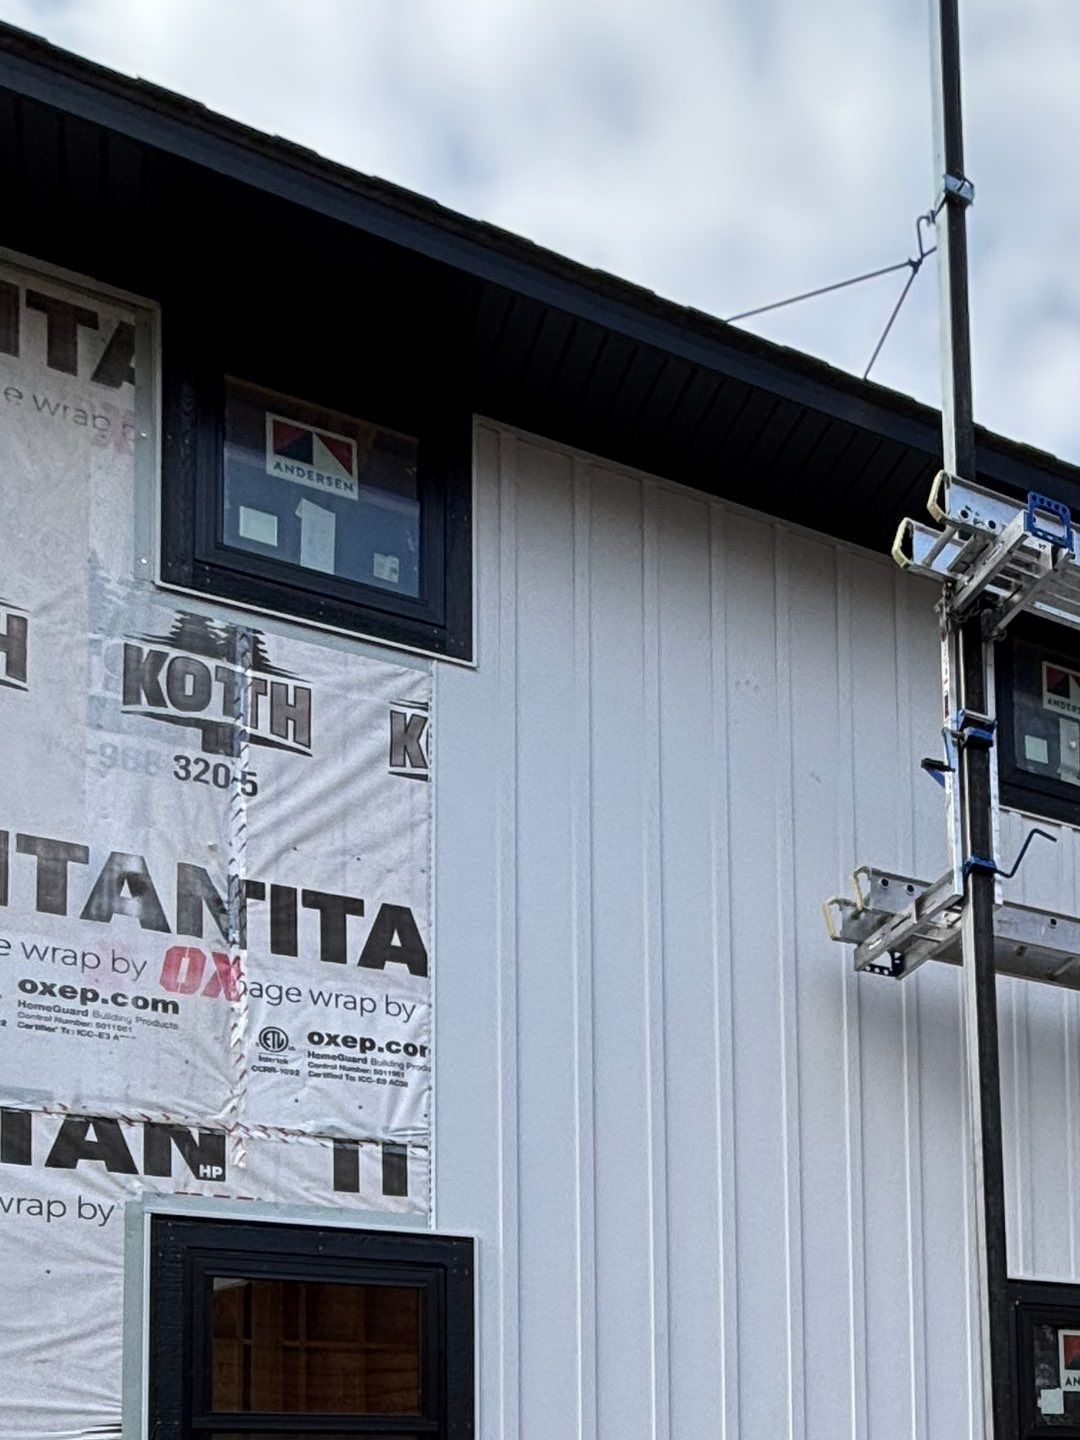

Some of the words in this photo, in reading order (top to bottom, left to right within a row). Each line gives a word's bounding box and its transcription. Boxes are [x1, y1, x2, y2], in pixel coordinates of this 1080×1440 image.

[32, 393, 111, 432] wrap
[273, 460, 354, 493] ANDERSEN
[122, 643, 312, 749] KOTH
[21, 938, 100, 973] wrap
[111, 946, 147, 982] by
[159, 945, 242, 1002] OX
[18, 978, 179, 1015] oxep.com
[309, 988, 376, 1017] wrap
[385, 994, 416, 1023] by
[18, 1000, 89, 1017] HomeGuard
[92, 1011, 132, 1025] Building
[135, 1016, 179, 1031] Products
[307, 1051, 367, 1065] HomeGuard
[371, 1057, 404, 1070] Building
[199, 1164, 224, 1179] HP
[78, 1195, 115, 1226] by
